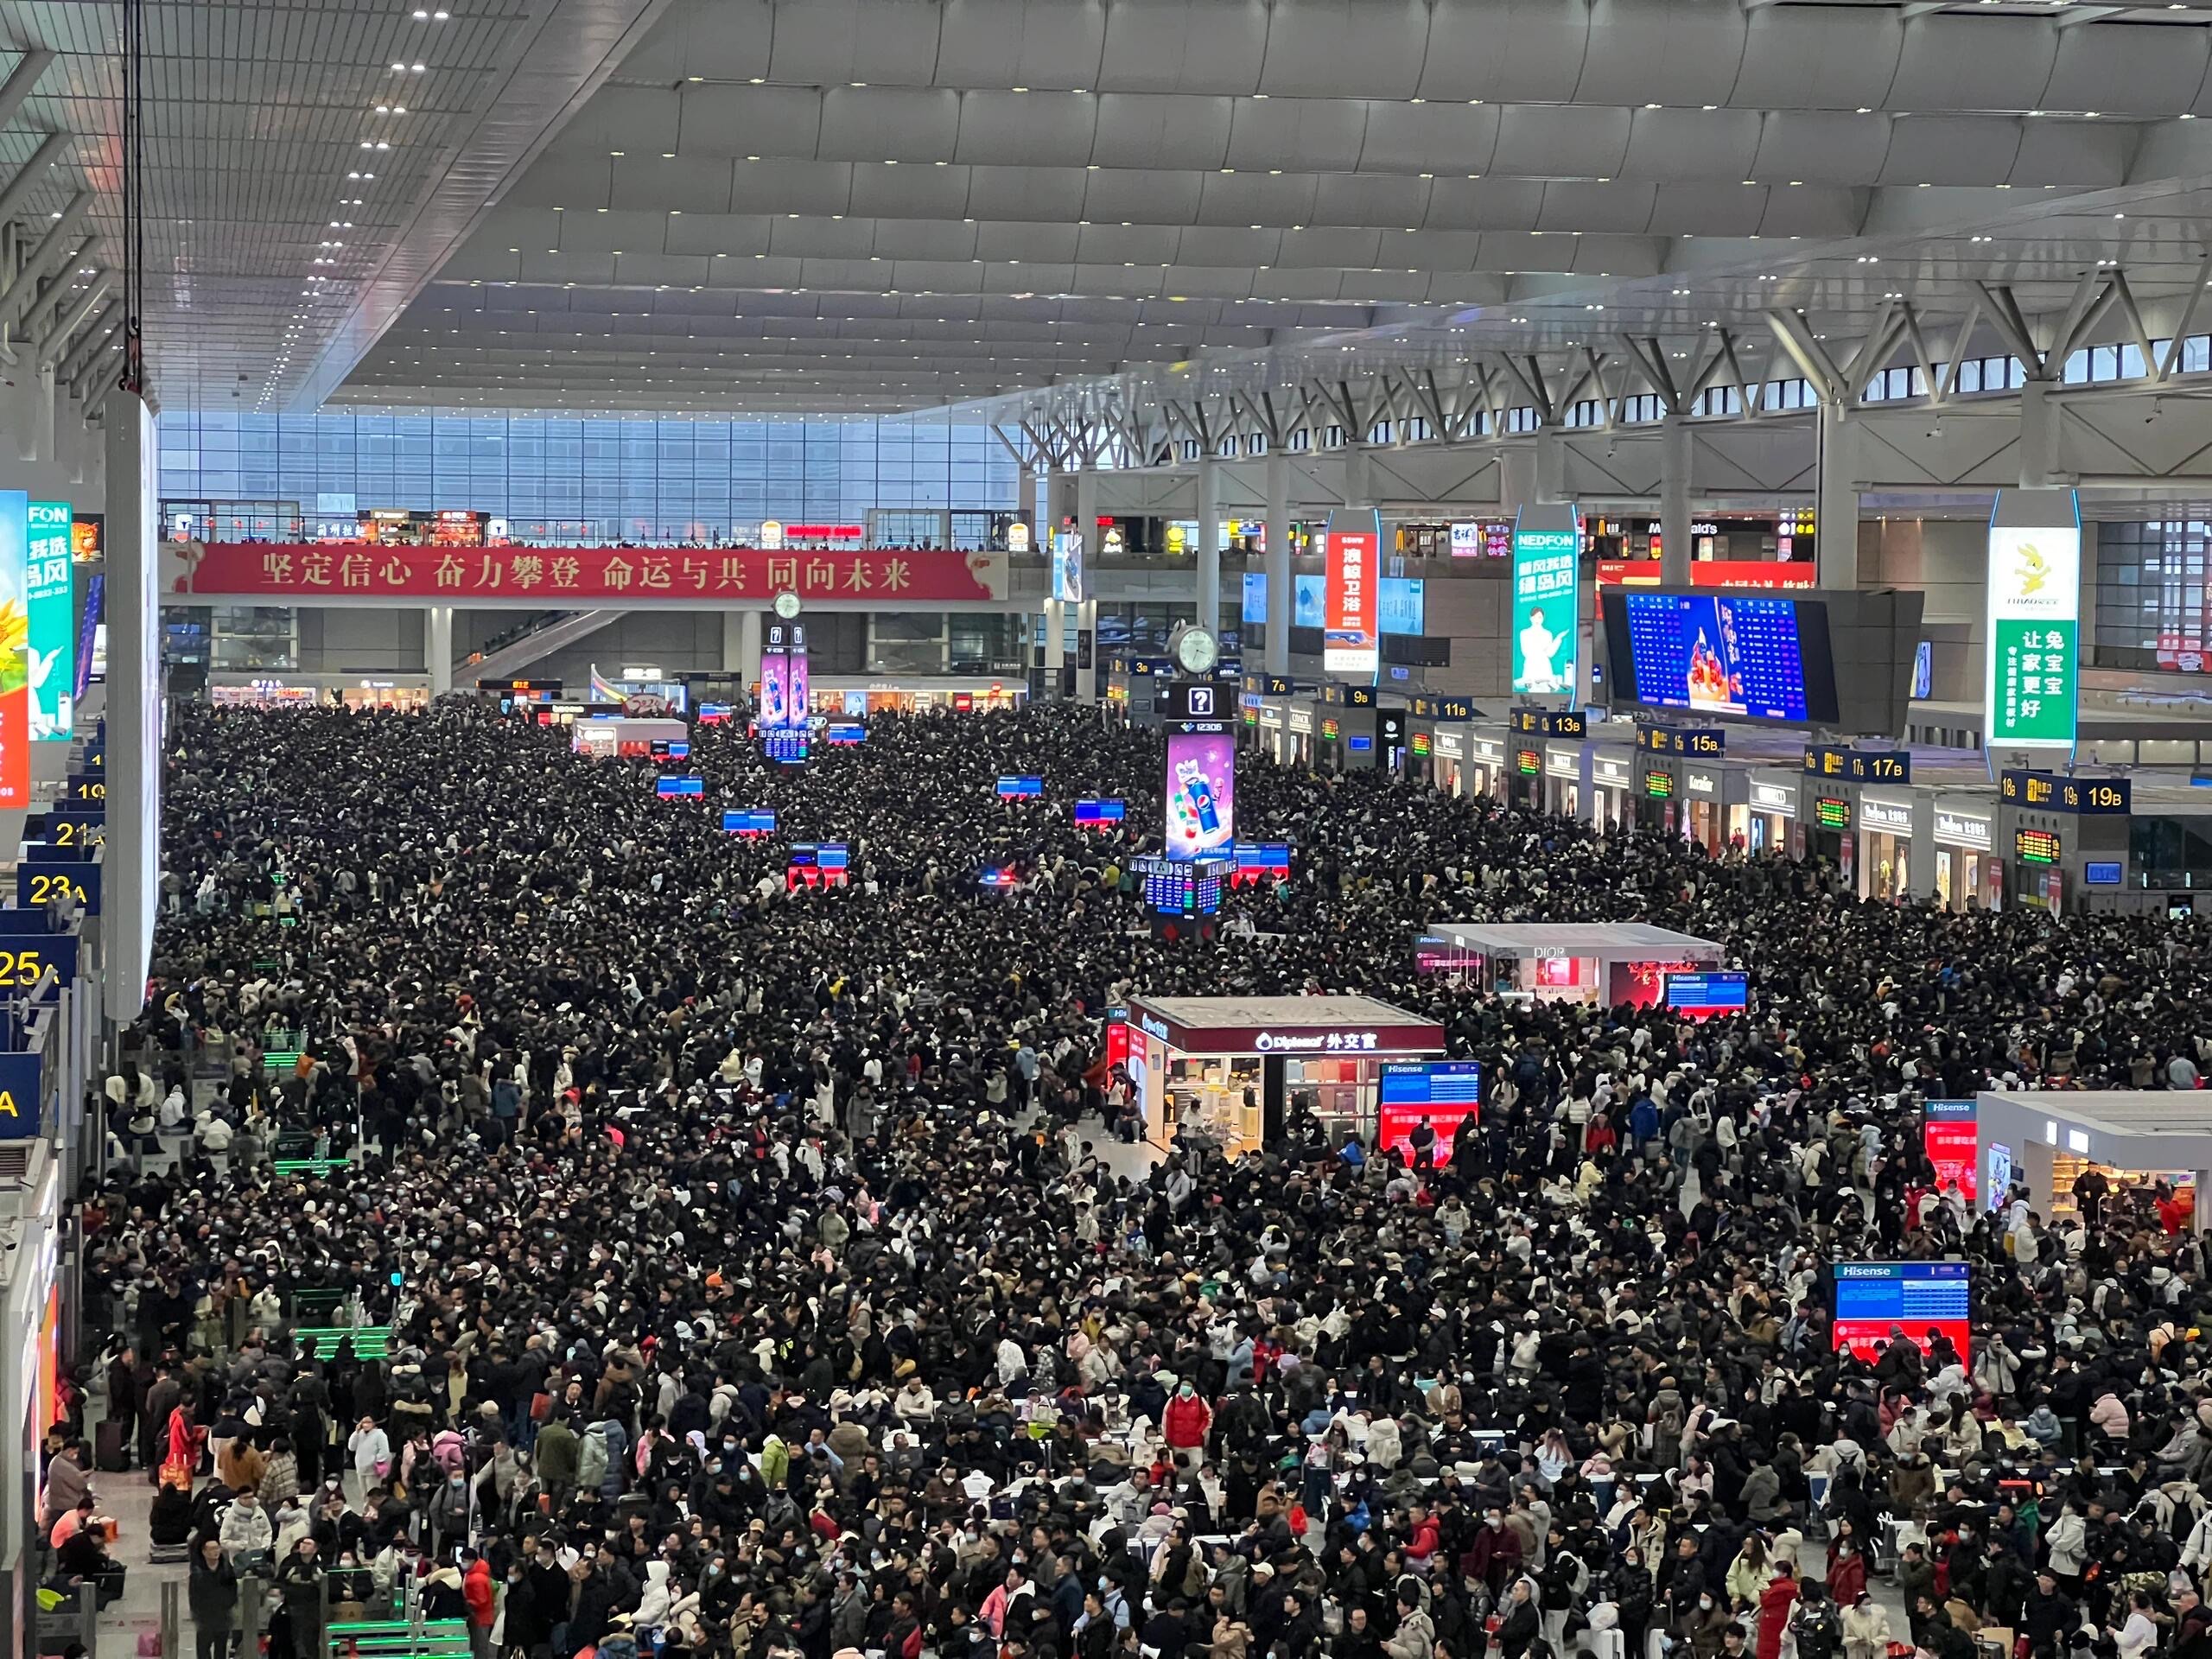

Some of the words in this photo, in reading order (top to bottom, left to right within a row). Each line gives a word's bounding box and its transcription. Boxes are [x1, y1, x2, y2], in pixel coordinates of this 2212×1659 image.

[1518, 535, 1573, 546] NEDFON
[261, 552, 412, 587] 坚定信心
[433, 554, 580, 589] 奋力攀登
[602, 556, 747, 590] 命运与共
[768, 557, 911, 592] 同向未来
[2044, 630, 2064, 695] 兔宝宝
[2021, 630, 2043, 718] 让家更好
[1272, 680, 1286, 691] 7B
[1354, 691, 1368, 702] 9B
[1445, 703, 1466, 716] 11B
[1197, 723, 1223, 732] 12306
[1556, 718, 1580, 732] 13B
[1691, 735, 1718, 751] 15B
[1872, 760, 1902, 776] 17B
[2003, 778, 2016, 797] 18B
[2063, 786, 2078, 805] 19B
[2088, 787, 2122, 806] 19B
[1327, 1033, 1377, 1049] 外交官
[1843, 1267, 1891, 1276] Hisense
